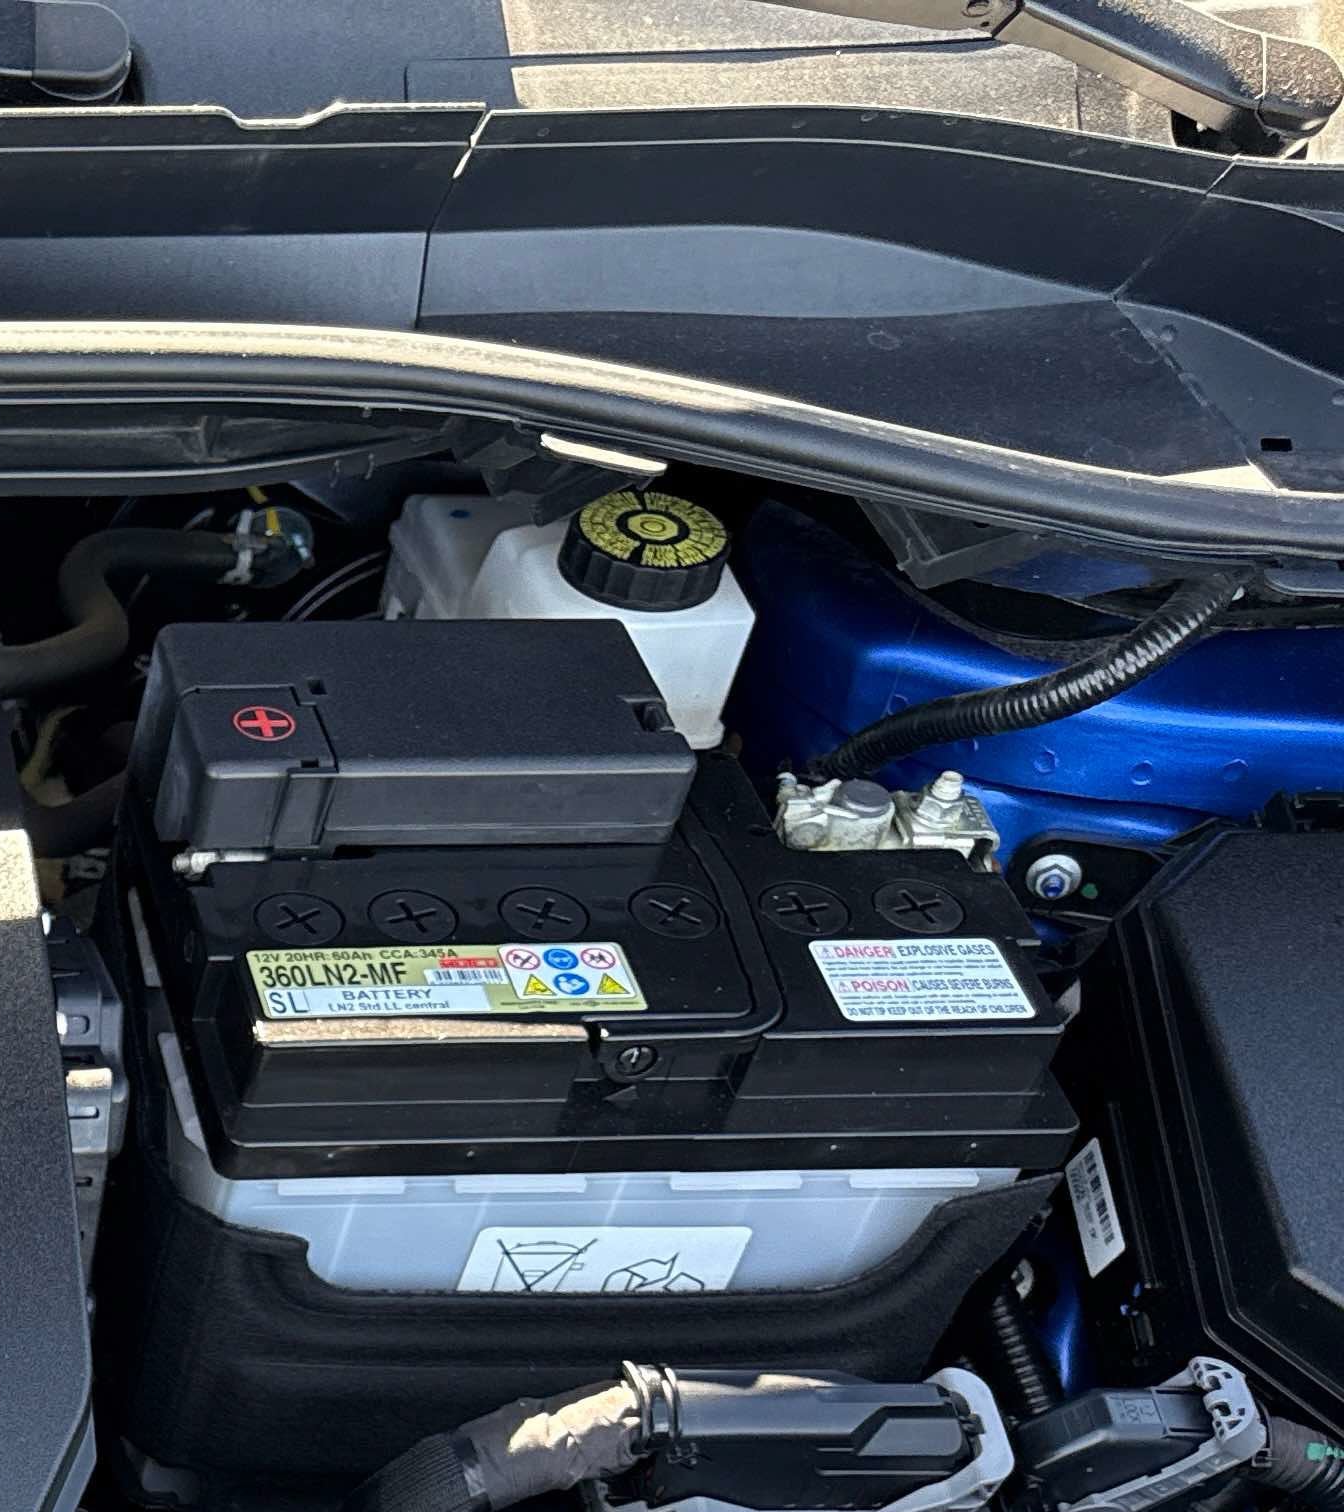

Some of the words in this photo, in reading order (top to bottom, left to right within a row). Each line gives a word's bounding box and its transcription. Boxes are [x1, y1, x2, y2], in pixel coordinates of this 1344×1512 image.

[253, 953, 280, 963] 12V
[379, 948, 458, 960] CCA:345A
[833, 946, 892, 958] DANGER
[896, 945, 957, 957] EXPLOSIVE
[959, 944, 995, 955] GASES
[259, 962, 408, 988] 360LN2-MF
[851, 979, 910, 993] POISON
[912, 979, 948, 991] CAUSES
[949, 978, 984, 990] SEVERE
[983, 978, 1015, 990] BURNS
[269, 990, 308, 1014] SL
[341, 988, 432, 1002] BATTERY
